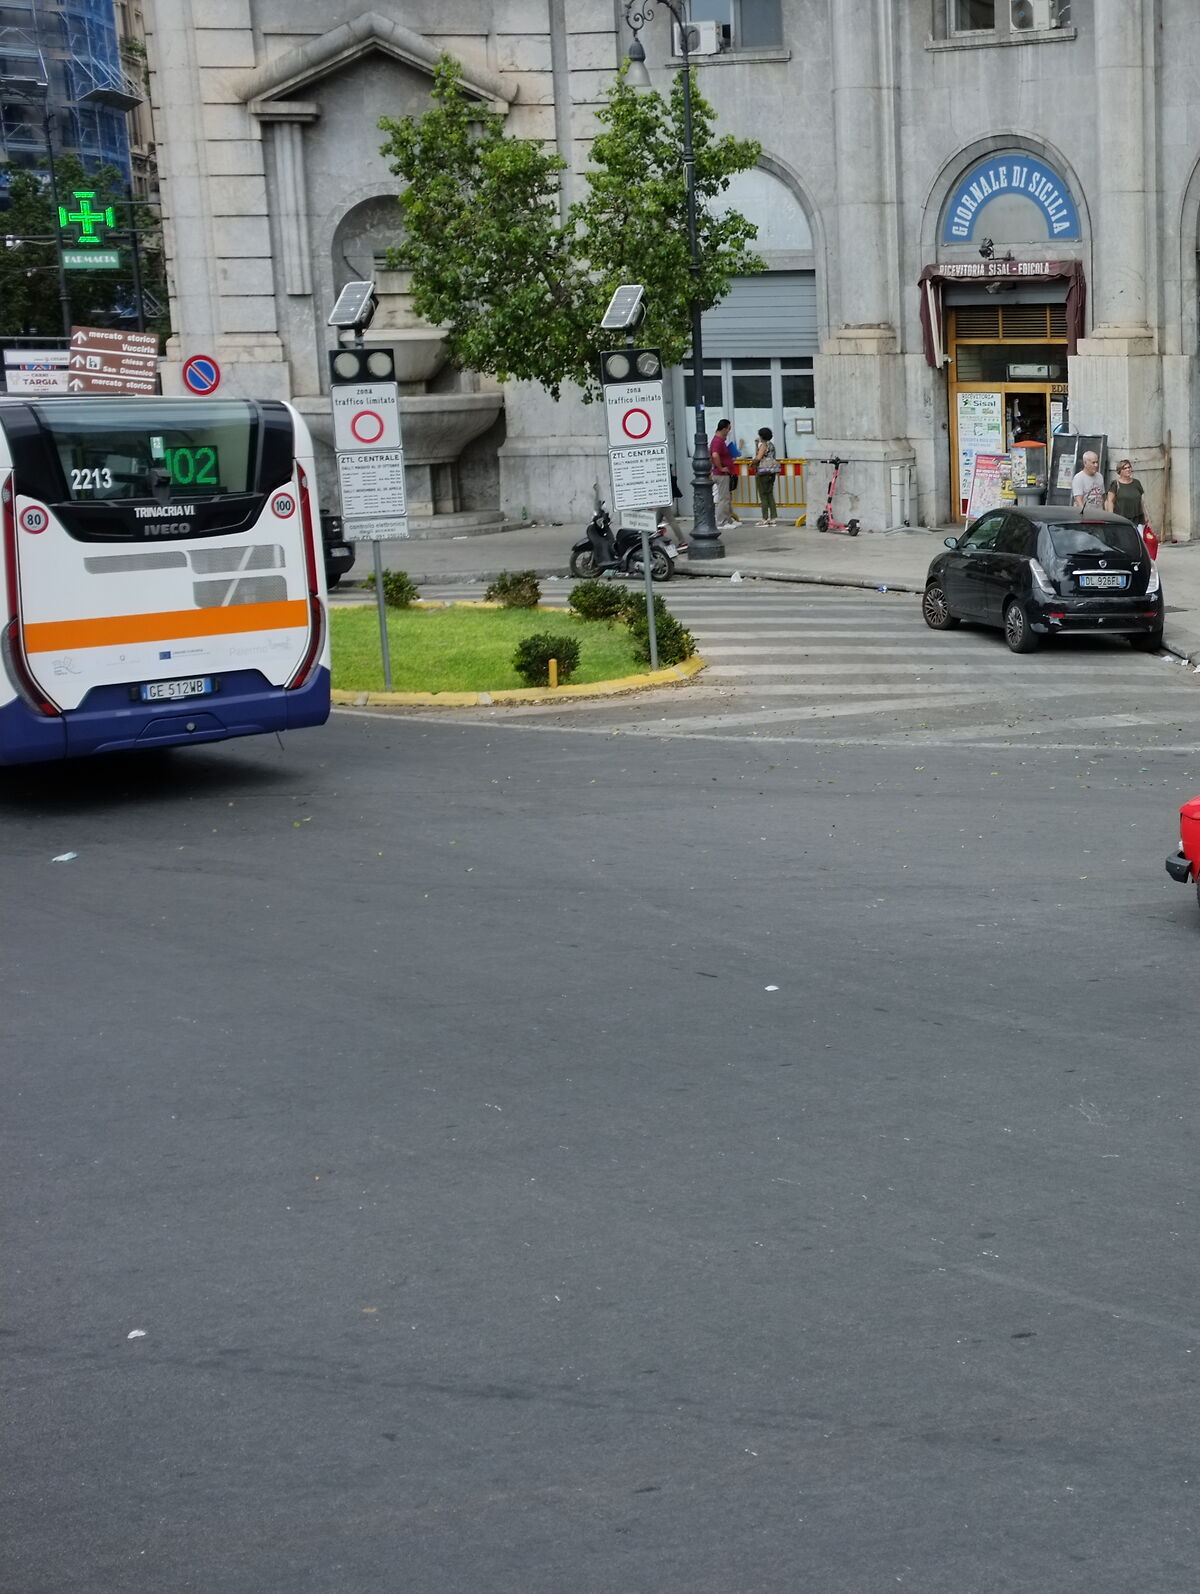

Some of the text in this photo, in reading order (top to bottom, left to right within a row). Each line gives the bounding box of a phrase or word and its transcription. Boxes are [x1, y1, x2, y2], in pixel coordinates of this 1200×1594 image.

[952, 166, 1070, 236] GIORNALE DI SICILIA
[988, 264, 1010, 276] SISAL
[1018, 262, 1050, 275] EDICOLA
[88, 332, 156, 344] mercato storico
[122, 344, 155, 353] Vucciria
[120, 367, 153, 376] Domenico
[92, 378, 152, 390] mercato storico
[1052, 384, 1068, 393] EDI
[335, 396, 395, 406] traffico limitato
[608, 395, 661, 405] traffico limitato
[358, 454, 399, 463] CENTRALE
[628, 448, 665, 458] CENTRALE
[164, 447, 217, 484] 102
[70, 468, 112, 490] 2213
[276, 500, 292, 511] 100
[134, 506, 184, 518] TRINACRIA
[26, 514, 42, 526] 80
[144, 522, 190, 536] IVECO
[149, 680, 204, 698] GE 512WB
